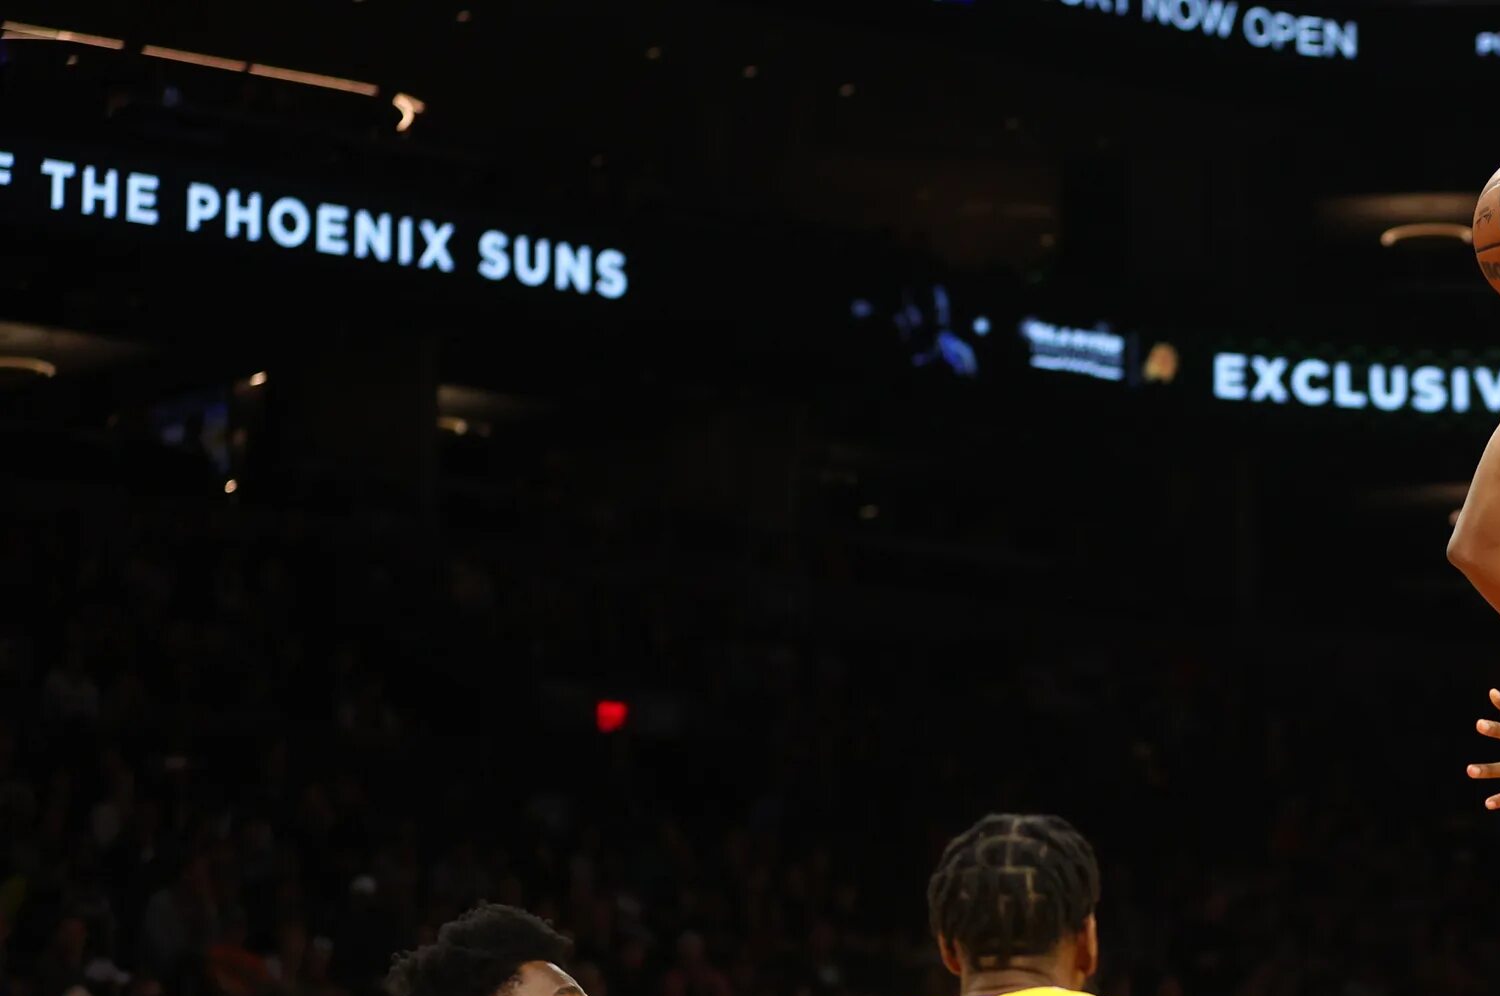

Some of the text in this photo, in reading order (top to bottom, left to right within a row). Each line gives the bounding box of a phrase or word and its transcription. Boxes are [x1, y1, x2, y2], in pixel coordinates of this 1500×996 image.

[1243, 7, 1358, 59] OPEN
[41, 158, 160, 225] THE
[185, 182, 456, 272] PHOENIX
[477, 229, 628, 299] SUNS
